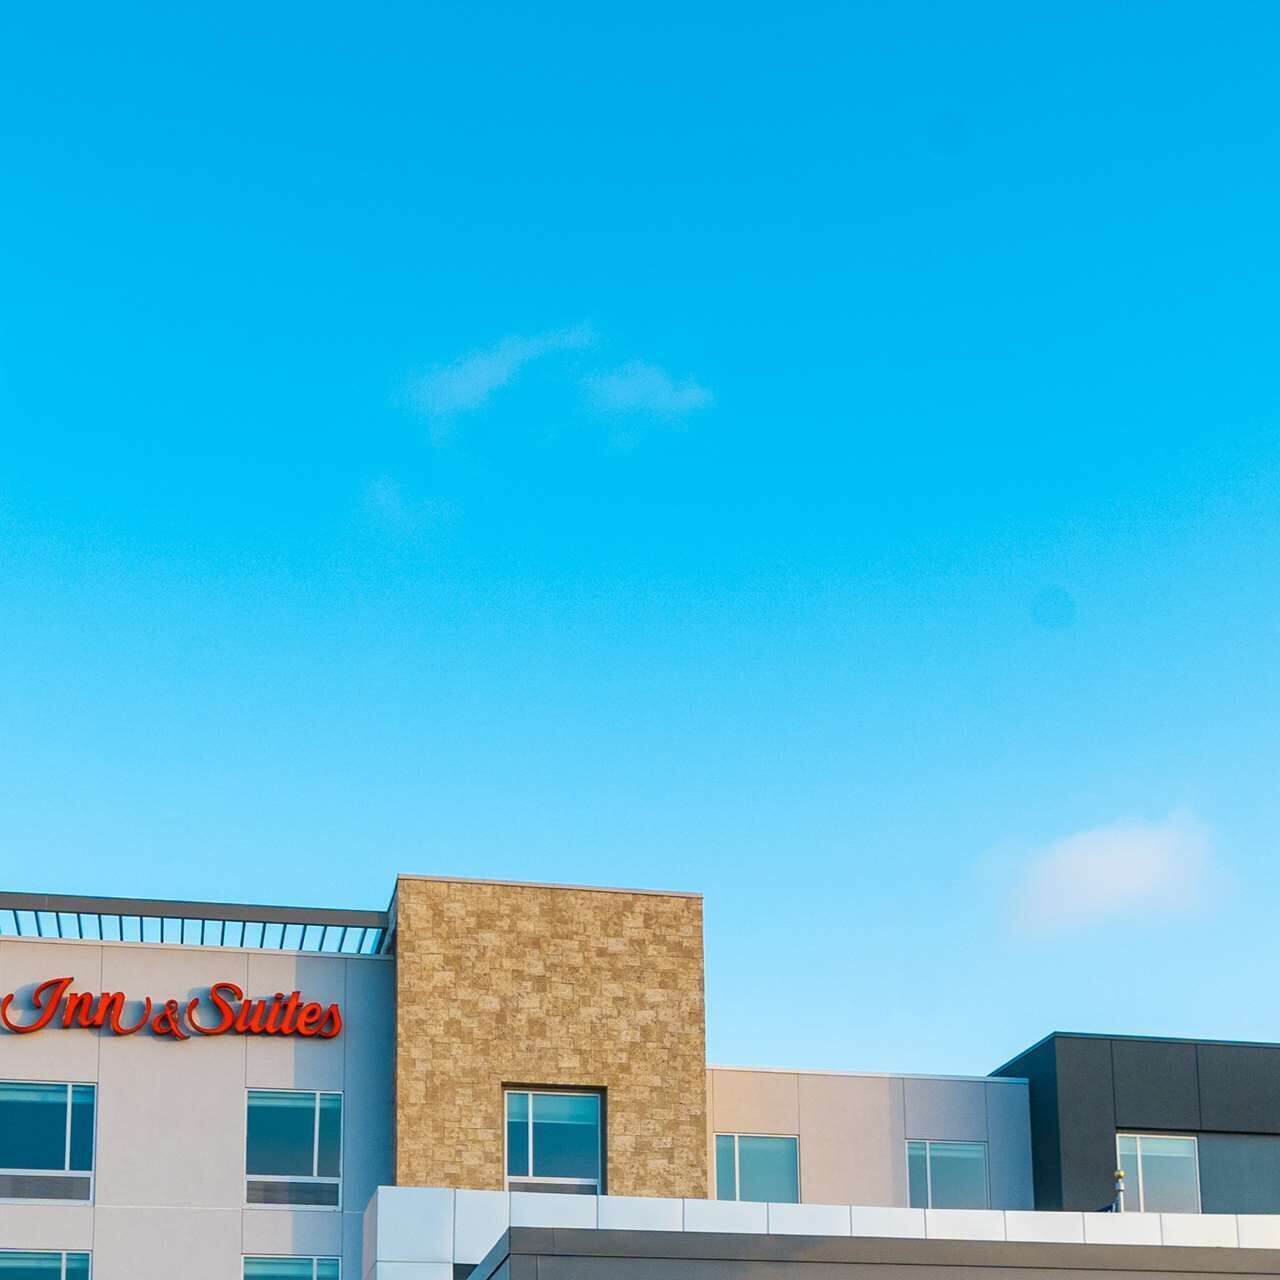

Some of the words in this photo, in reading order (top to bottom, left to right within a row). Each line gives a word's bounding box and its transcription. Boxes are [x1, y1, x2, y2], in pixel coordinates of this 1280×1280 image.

[0, 976, 152, 1035] Inn
[151, 998, 190, 1040] &
[186, 981, 343, 1039] Suites
